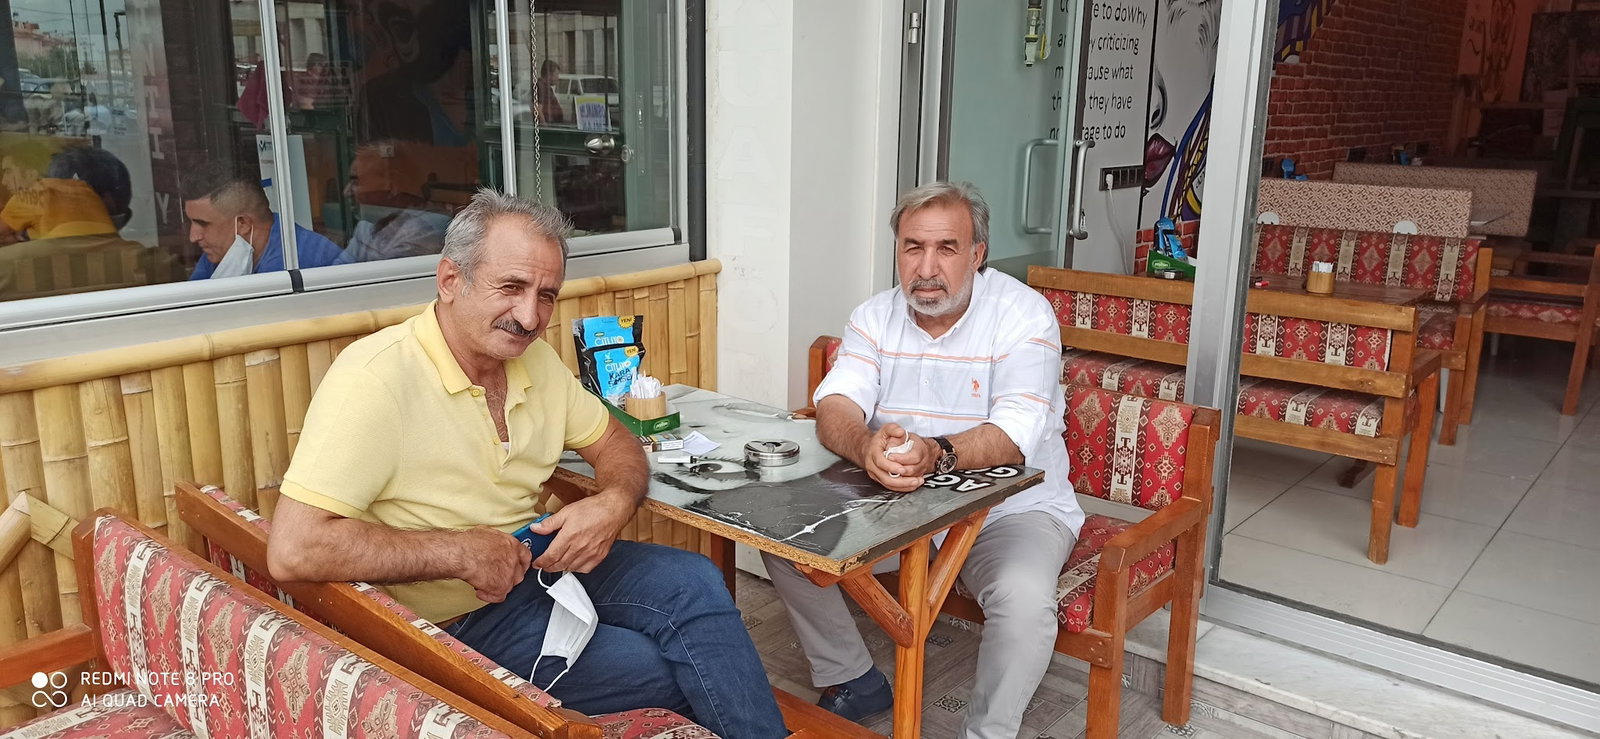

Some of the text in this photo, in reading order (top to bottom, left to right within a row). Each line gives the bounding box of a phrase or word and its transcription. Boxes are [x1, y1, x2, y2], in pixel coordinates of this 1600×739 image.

[1102, 2, 1112, 20] to
[1097, 32, 1140, 56] criticizing
[1086, 62, 1134, 80] ause what
[1089, 91, 1133, 115] they have
[1102, 124, 1112, 140] to
[1114, 121, 1126, 139] do
[608, 368, 631, 380] KARA
